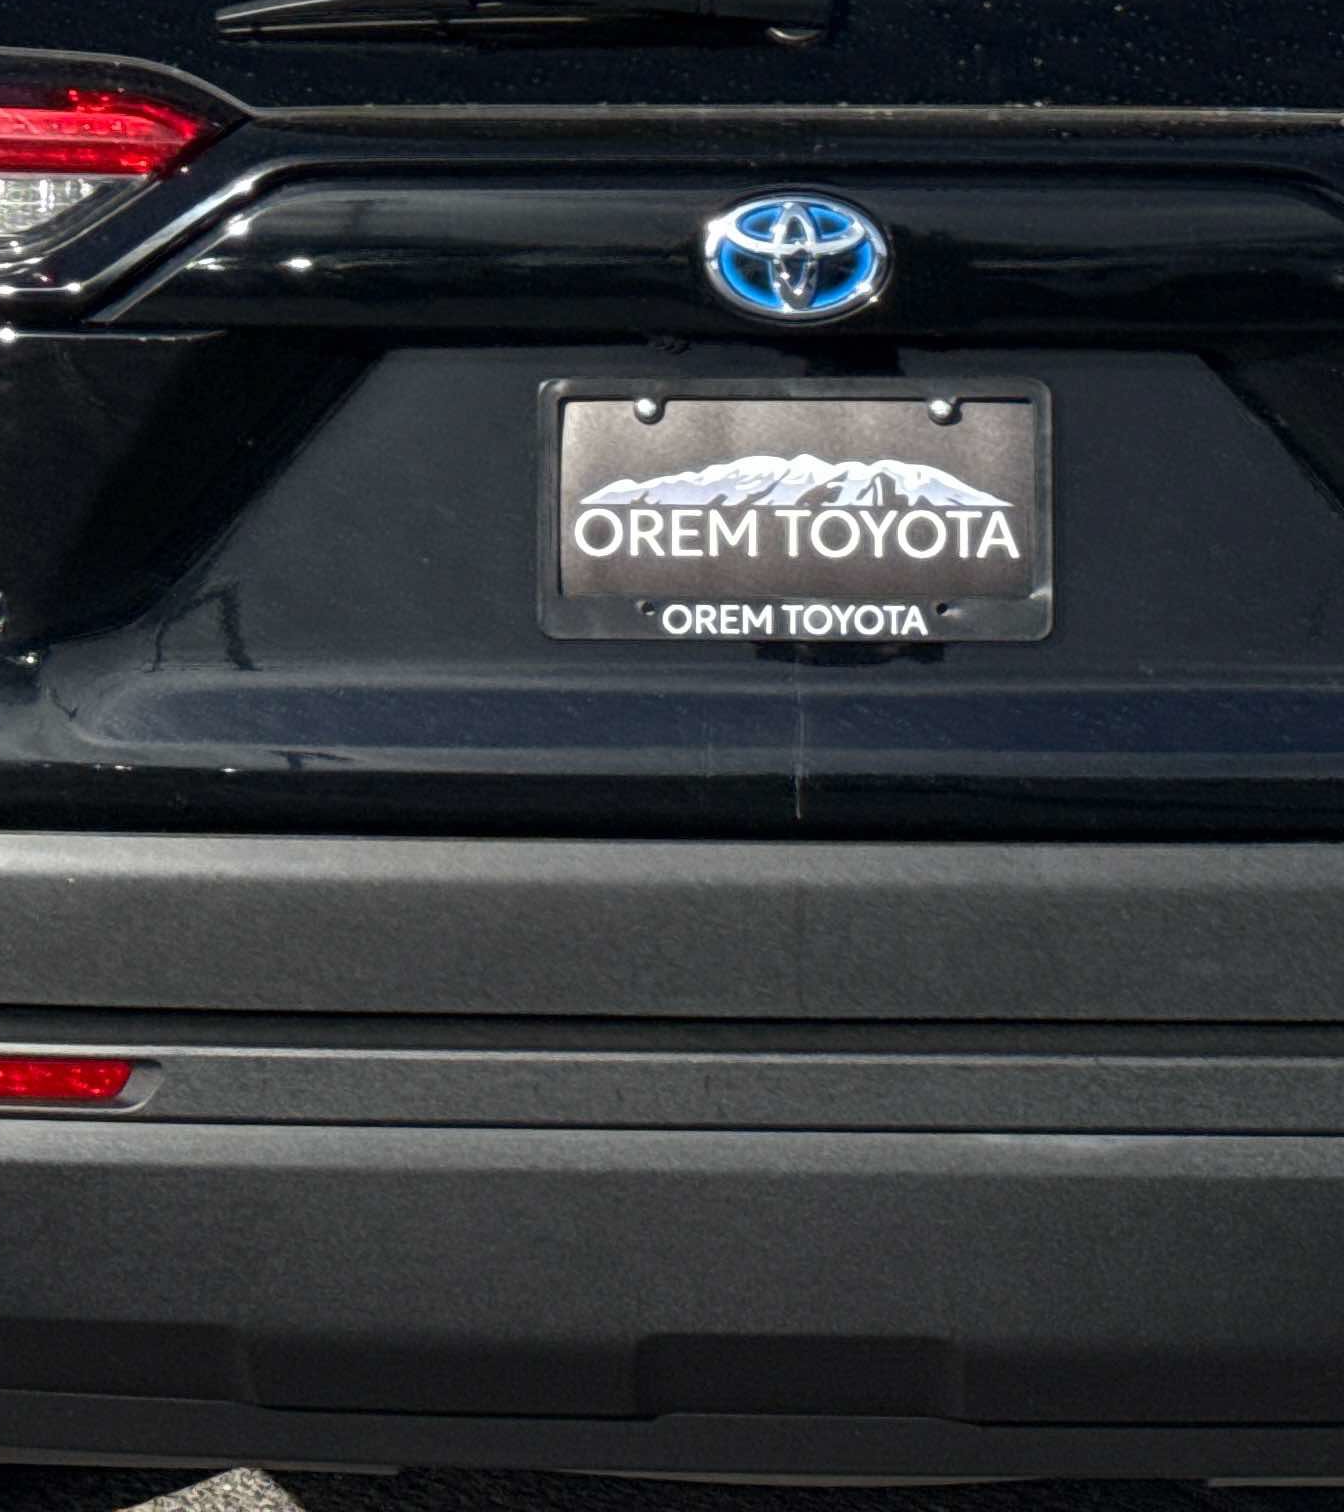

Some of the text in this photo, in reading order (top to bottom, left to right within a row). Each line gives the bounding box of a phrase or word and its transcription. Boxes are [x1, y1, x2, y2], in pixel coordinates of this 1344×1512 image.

[574, 508, 1021, 560] OREM TOYOTA
[661, 603, 929, 636] OREM TOYOTA
